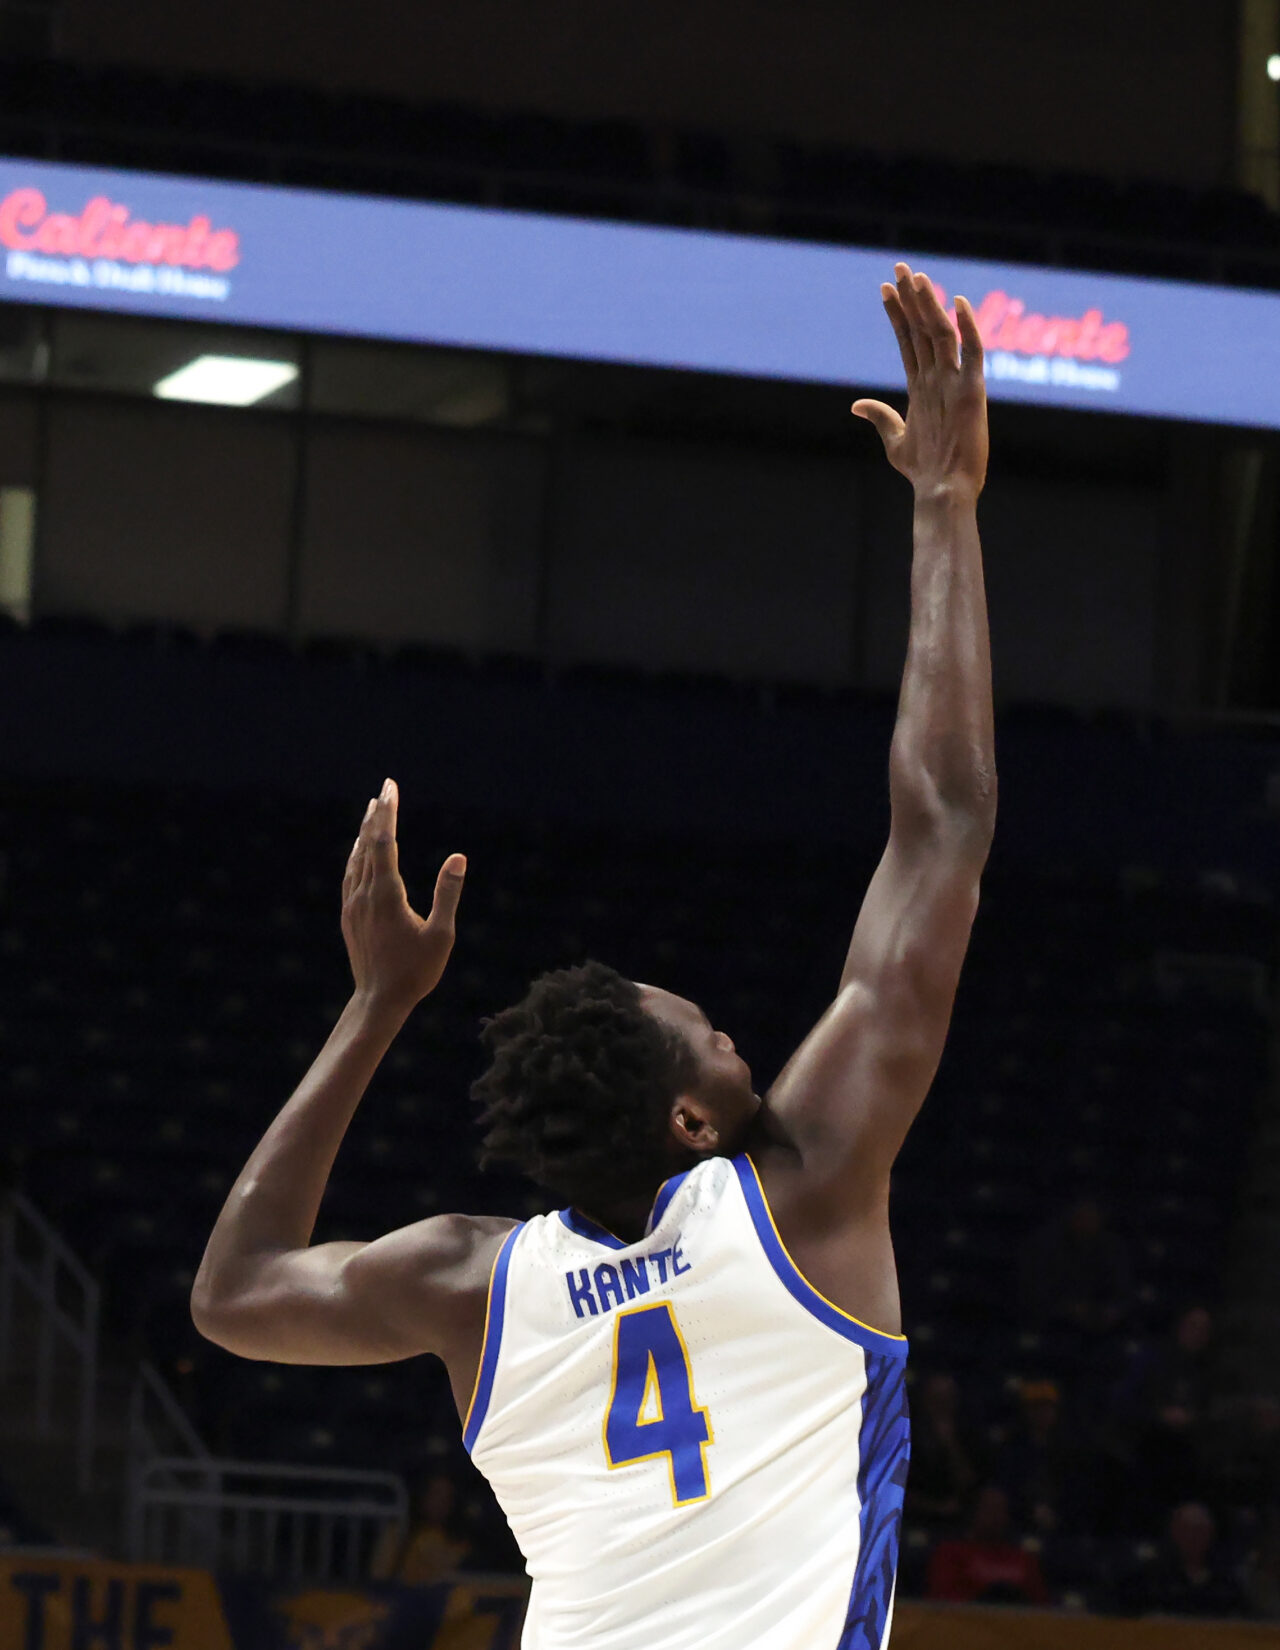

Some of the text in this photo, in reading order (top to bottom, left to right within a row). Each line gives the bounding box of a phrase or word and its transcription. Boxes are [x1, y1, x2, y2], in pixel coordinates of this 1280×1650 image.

[0, 187, 240, 272] Caliente
[932, 283, 1130, 363] liente
[565, 1232, 692, 1319] KANTE
[602, 1300, 715, 1508] 4
[11, 1570, 184, 1650] THE
